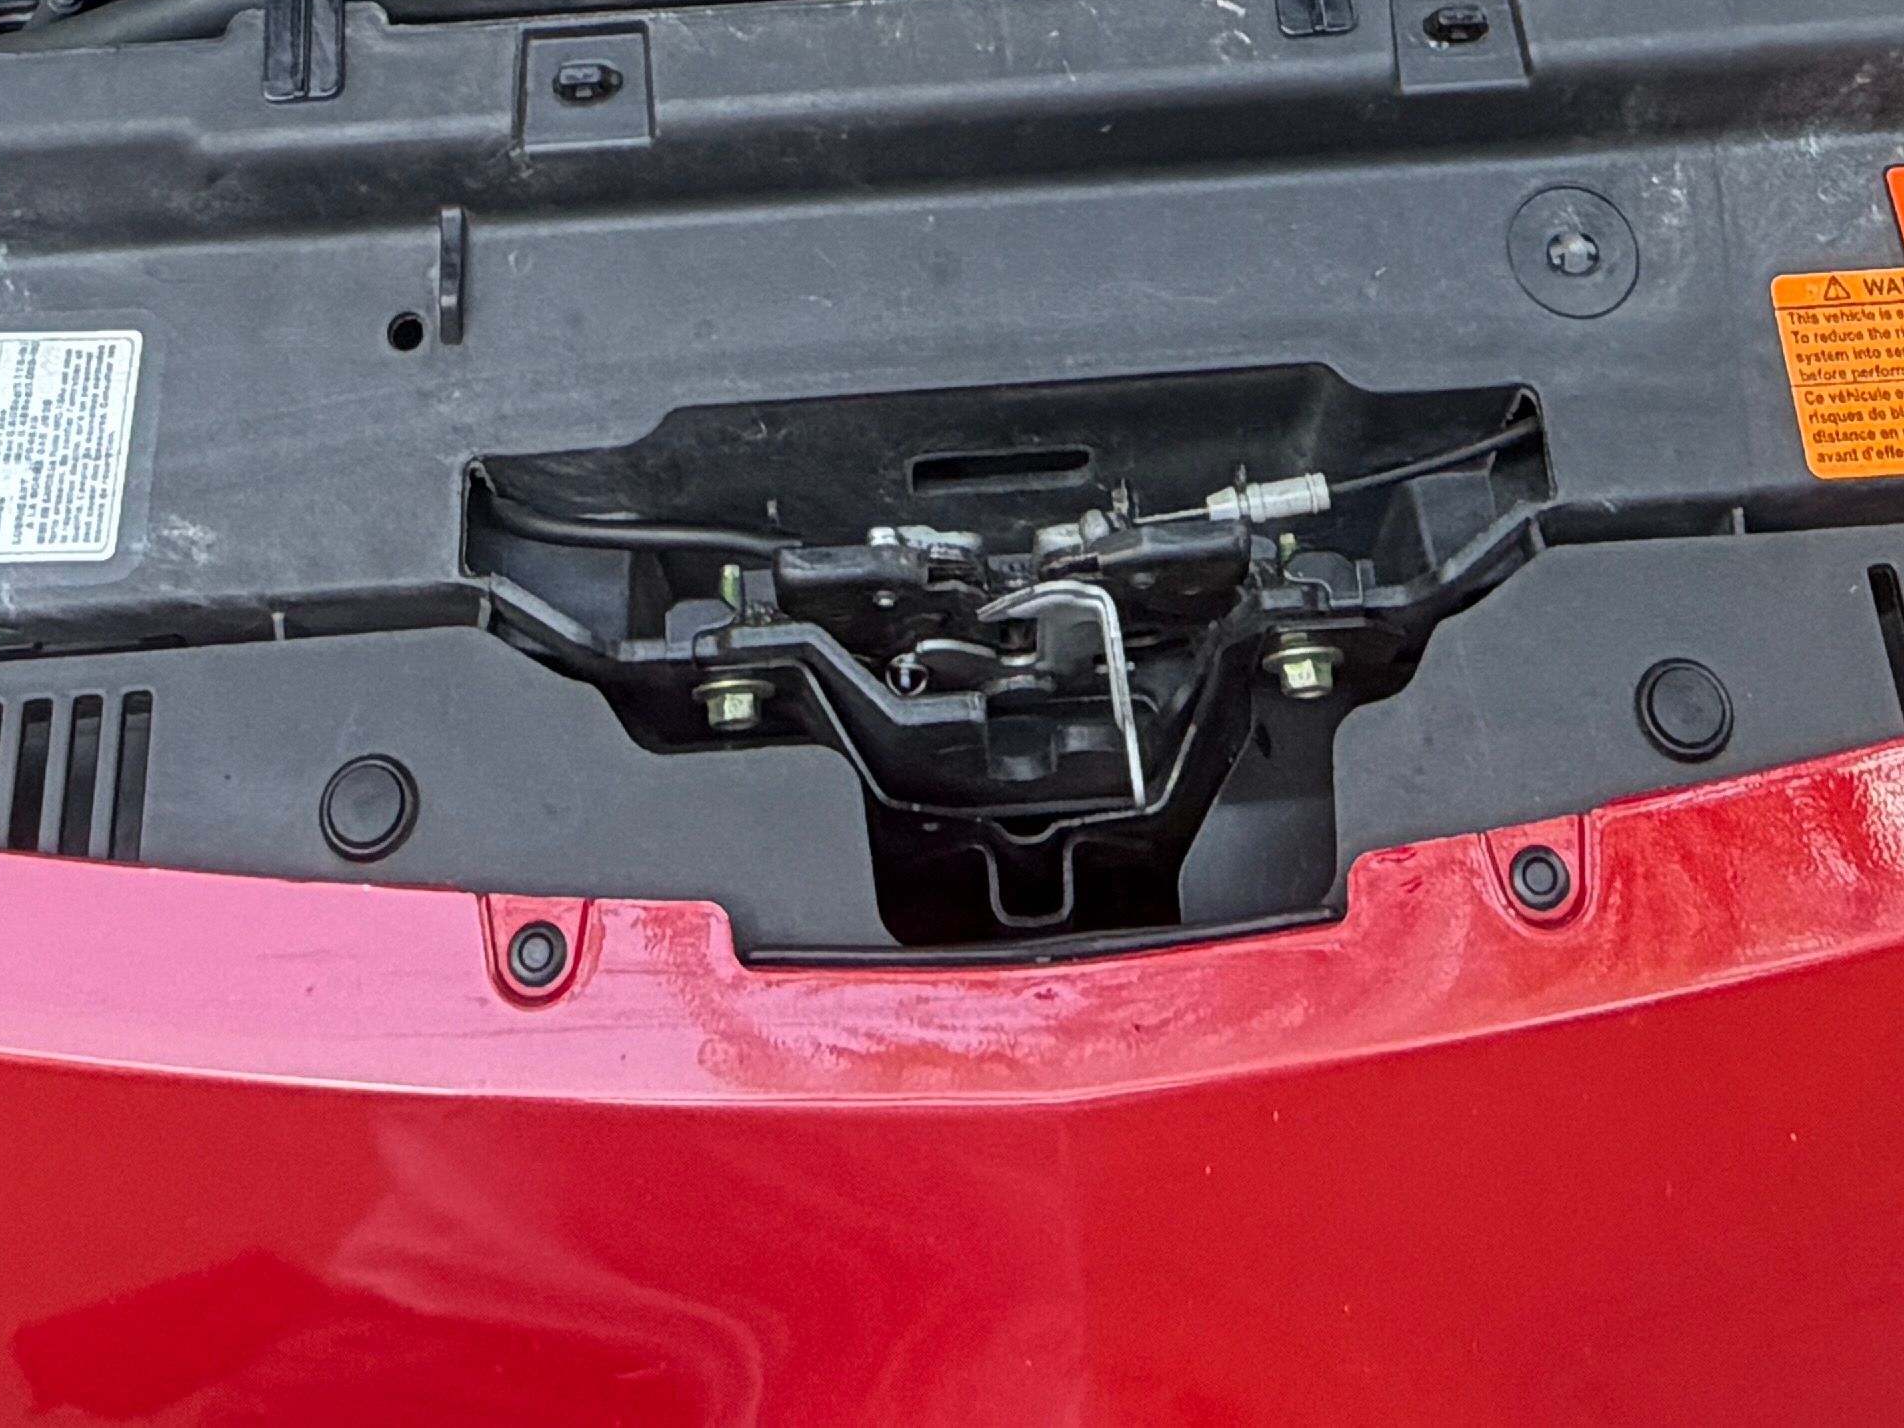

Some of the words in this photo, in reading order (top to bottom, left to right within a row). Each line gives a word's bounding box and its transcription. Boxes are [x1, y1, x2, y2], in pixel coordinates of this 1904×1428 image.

[1788, 311, 1819, 327] This
[1824, 308, 1875, 324] vehicle
[1879, 307, 1891, 321] is
[1792, 330, 1808, 345] To
[1813, 327, 1863, 344] reduce
[1868, 325, 1890, 340] the
[1796, 348, 1848, 366] system
[1853, 346, 1881, 362] into
[1800, 366, 1846, 383] before
[1805, 390, 1824, 405] Ce
[1808, 408, 1862, 425] risques
[1867, 406, 1885, 421] de
[1812, 427, 1876, 443] distance
[1880, 426, 1898, 439] en
[1816, 448, 1857, 463] avant
